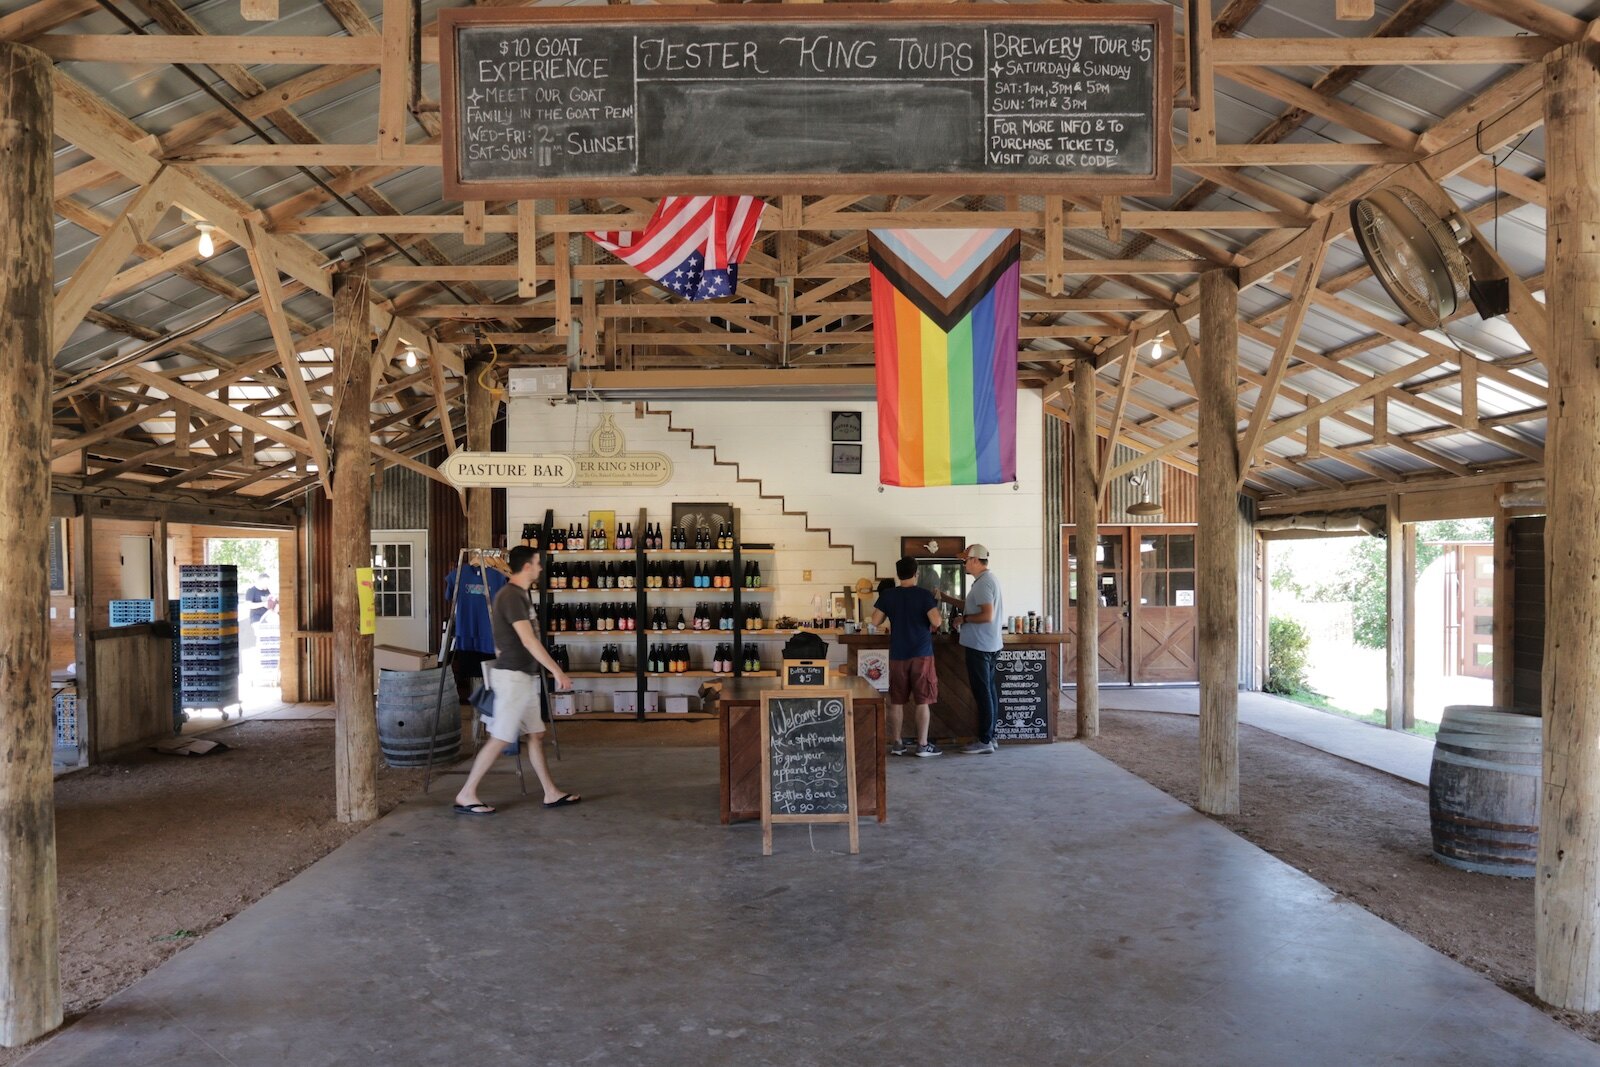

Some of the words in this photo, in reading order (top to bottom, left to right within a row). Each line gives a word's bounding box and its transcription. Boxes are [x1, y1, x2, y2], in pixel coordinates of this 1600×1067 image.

[499, 38, 530, 57] $10
[535, 37, 583, 57] GOAT
[640, 38, 769, 73] JESTER
[780, 35, 877, 72] KING
[889, 38, 973, 76] TOURS
[993, 33, 1082, 61] BREWERY
[1089, 35, 1131, 57] TOUR
[1131, 38, 1152, 61] $5
[479, 58, 608, 82] EXPERIENCE
[1006, 60, 1070, 79] SATURDAY
[1072, 62, 1081, 73] &
[1083, 61, 1131, 80] SUNDAY
[485, 87, 528, 103] MEET
[535, 87, 563, 104] OUR
[569, 86, 606, 102] GOAT
[995, 82, 1022, 95] SAT:
[1049, 82, 1073, 95] 3PM
[1074, 81, 1082, 91] &
[1086, 81, 1110, 94] 5PM
[992, 98, 1025, 112] SUN:
[1028, 97, 1048, 110] 1PM
[1049, 98, 1057, 109] &
[1061, 97, 1087, 110] 3PM
[467, 106, 513, 125] FAMILY
[520, 109, 531, 119] IN
[537, 108, 563, 120] THE
[566, 107, 600, 120] GOAT
[604, 105, 634, 119] PEN!
[468, 126, 531, 144] WED-FRI:
[993, 118, 1018, 135] FOR
[1022, 119, 1055, 135] MORE
[1060, 120, 1092, 135] INFO
[1095, 119, 1105, 132] &
[1107, 119, 1124, 133] TO
[469, 144, 533, 161] SAT-SUN:
[567, 132, 635, 155] SUNSET
[990, 136, 1053, 150] PURCHASE
[1058, 137, 1119, 155] TICKETS,
[990, 152, 1025, 165] VISIT
[1027, 154, 1051, 165] OUR
[1055, 153, 1077, 166] QR
[1079, 154, 1118, 167] CODE
[458, 463, 527, 476] PASTURE
[533, 464, 564, 477] BAR
[598, 461, 627, 471] KING
[629, 461, 661, 471] SHOP
[800, 675, 811, 683] $5
[771, 700, 822, 736] Welcome!
[796, 732, 818, 750] staff
[818, 734, 845, 745] member
[773, 752, 783, 765] to
[784, 752, 803, 769] grab
[803, 751, 825, 766] your
[773, 764, 808, 783] apparel
[773, 788, 804, 802] Bottles
[805, 788, 813, 801] &
[814, 790, 836, 799] cans
[780, 800, 796, 814] to
[799, 803, 814, 813] go
